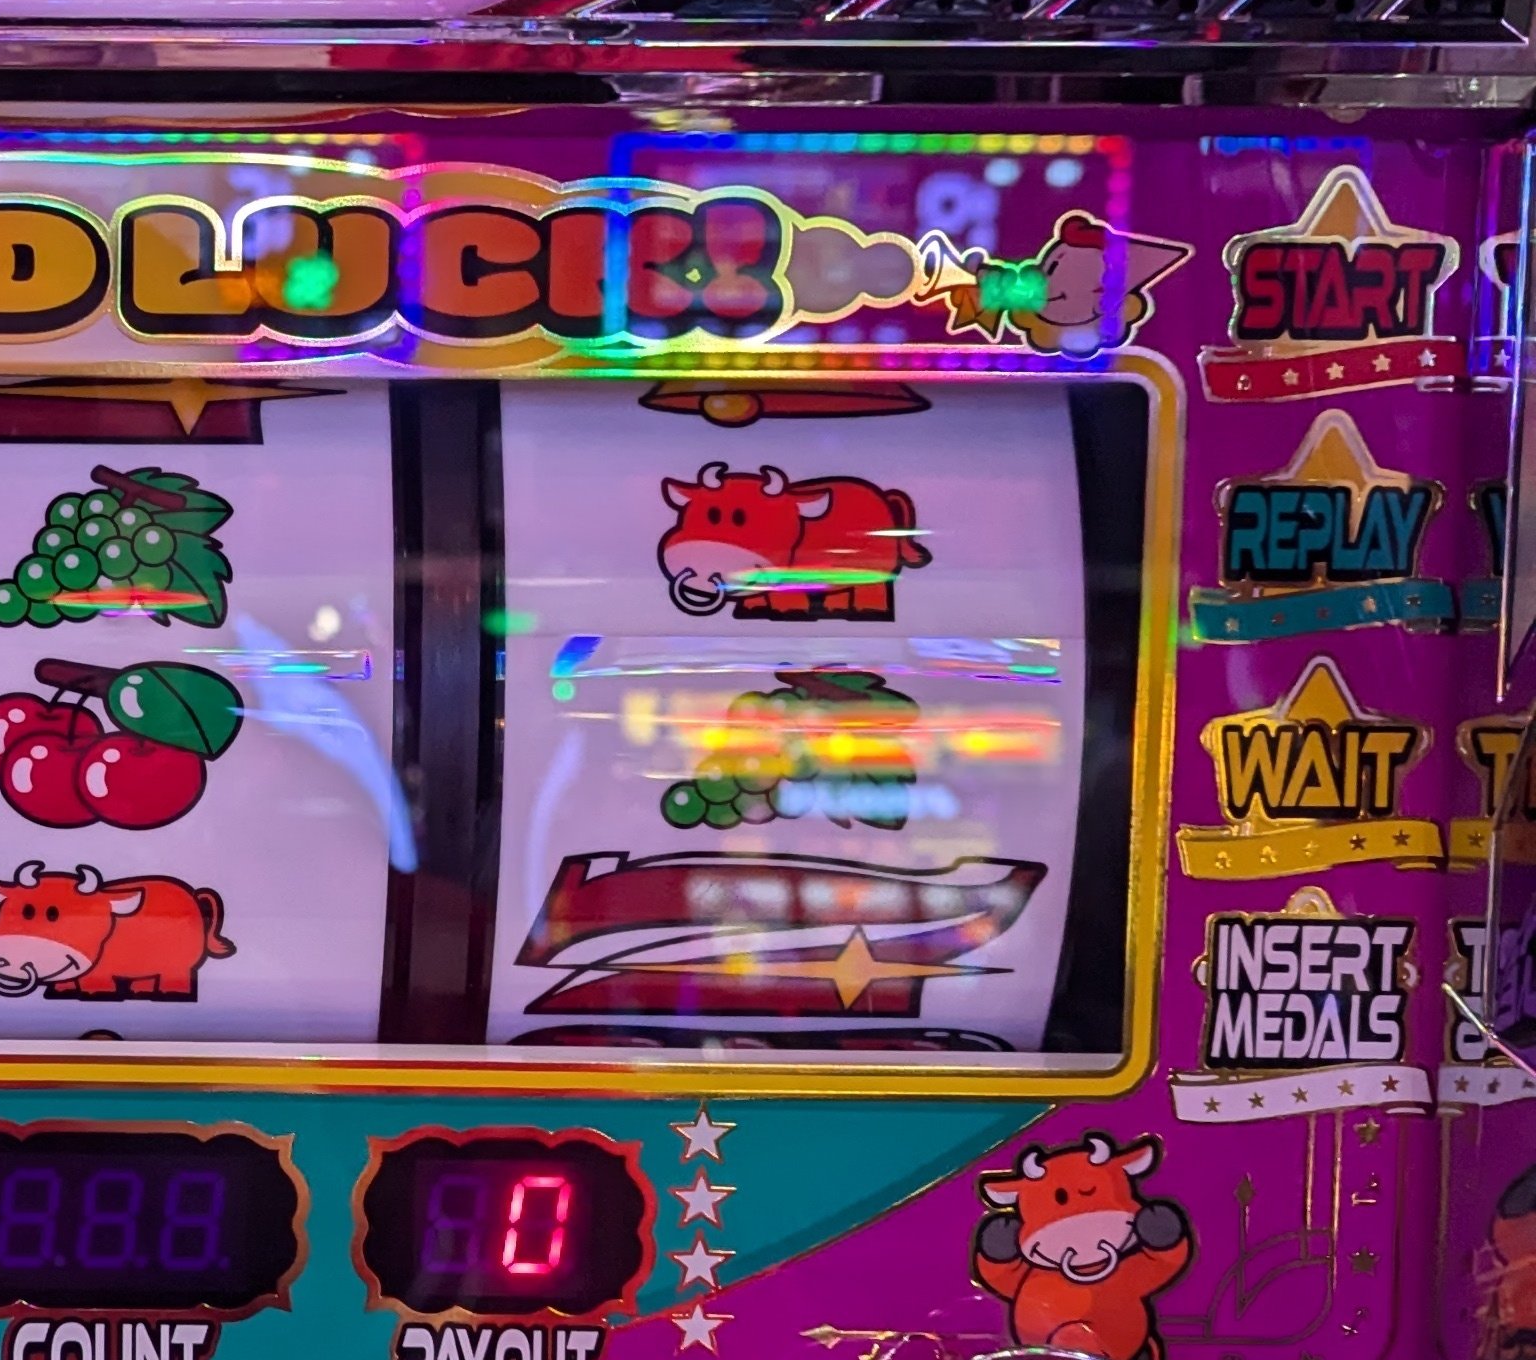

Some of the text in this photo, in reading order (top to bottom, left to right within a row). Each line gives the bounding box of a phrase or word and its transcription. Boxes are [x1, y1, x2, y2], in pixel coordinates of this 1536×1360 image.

[1240, 245, 1439, 332] START
[1228, 490, 1427, 572] REPLAY
[1225, 730, 1411, 810] WAIT
[1216, 923, 1408, 992] INSERT
[1210, 992, 1404, 1061] MEDALS
[501, 1175, 572, 1275] 0
